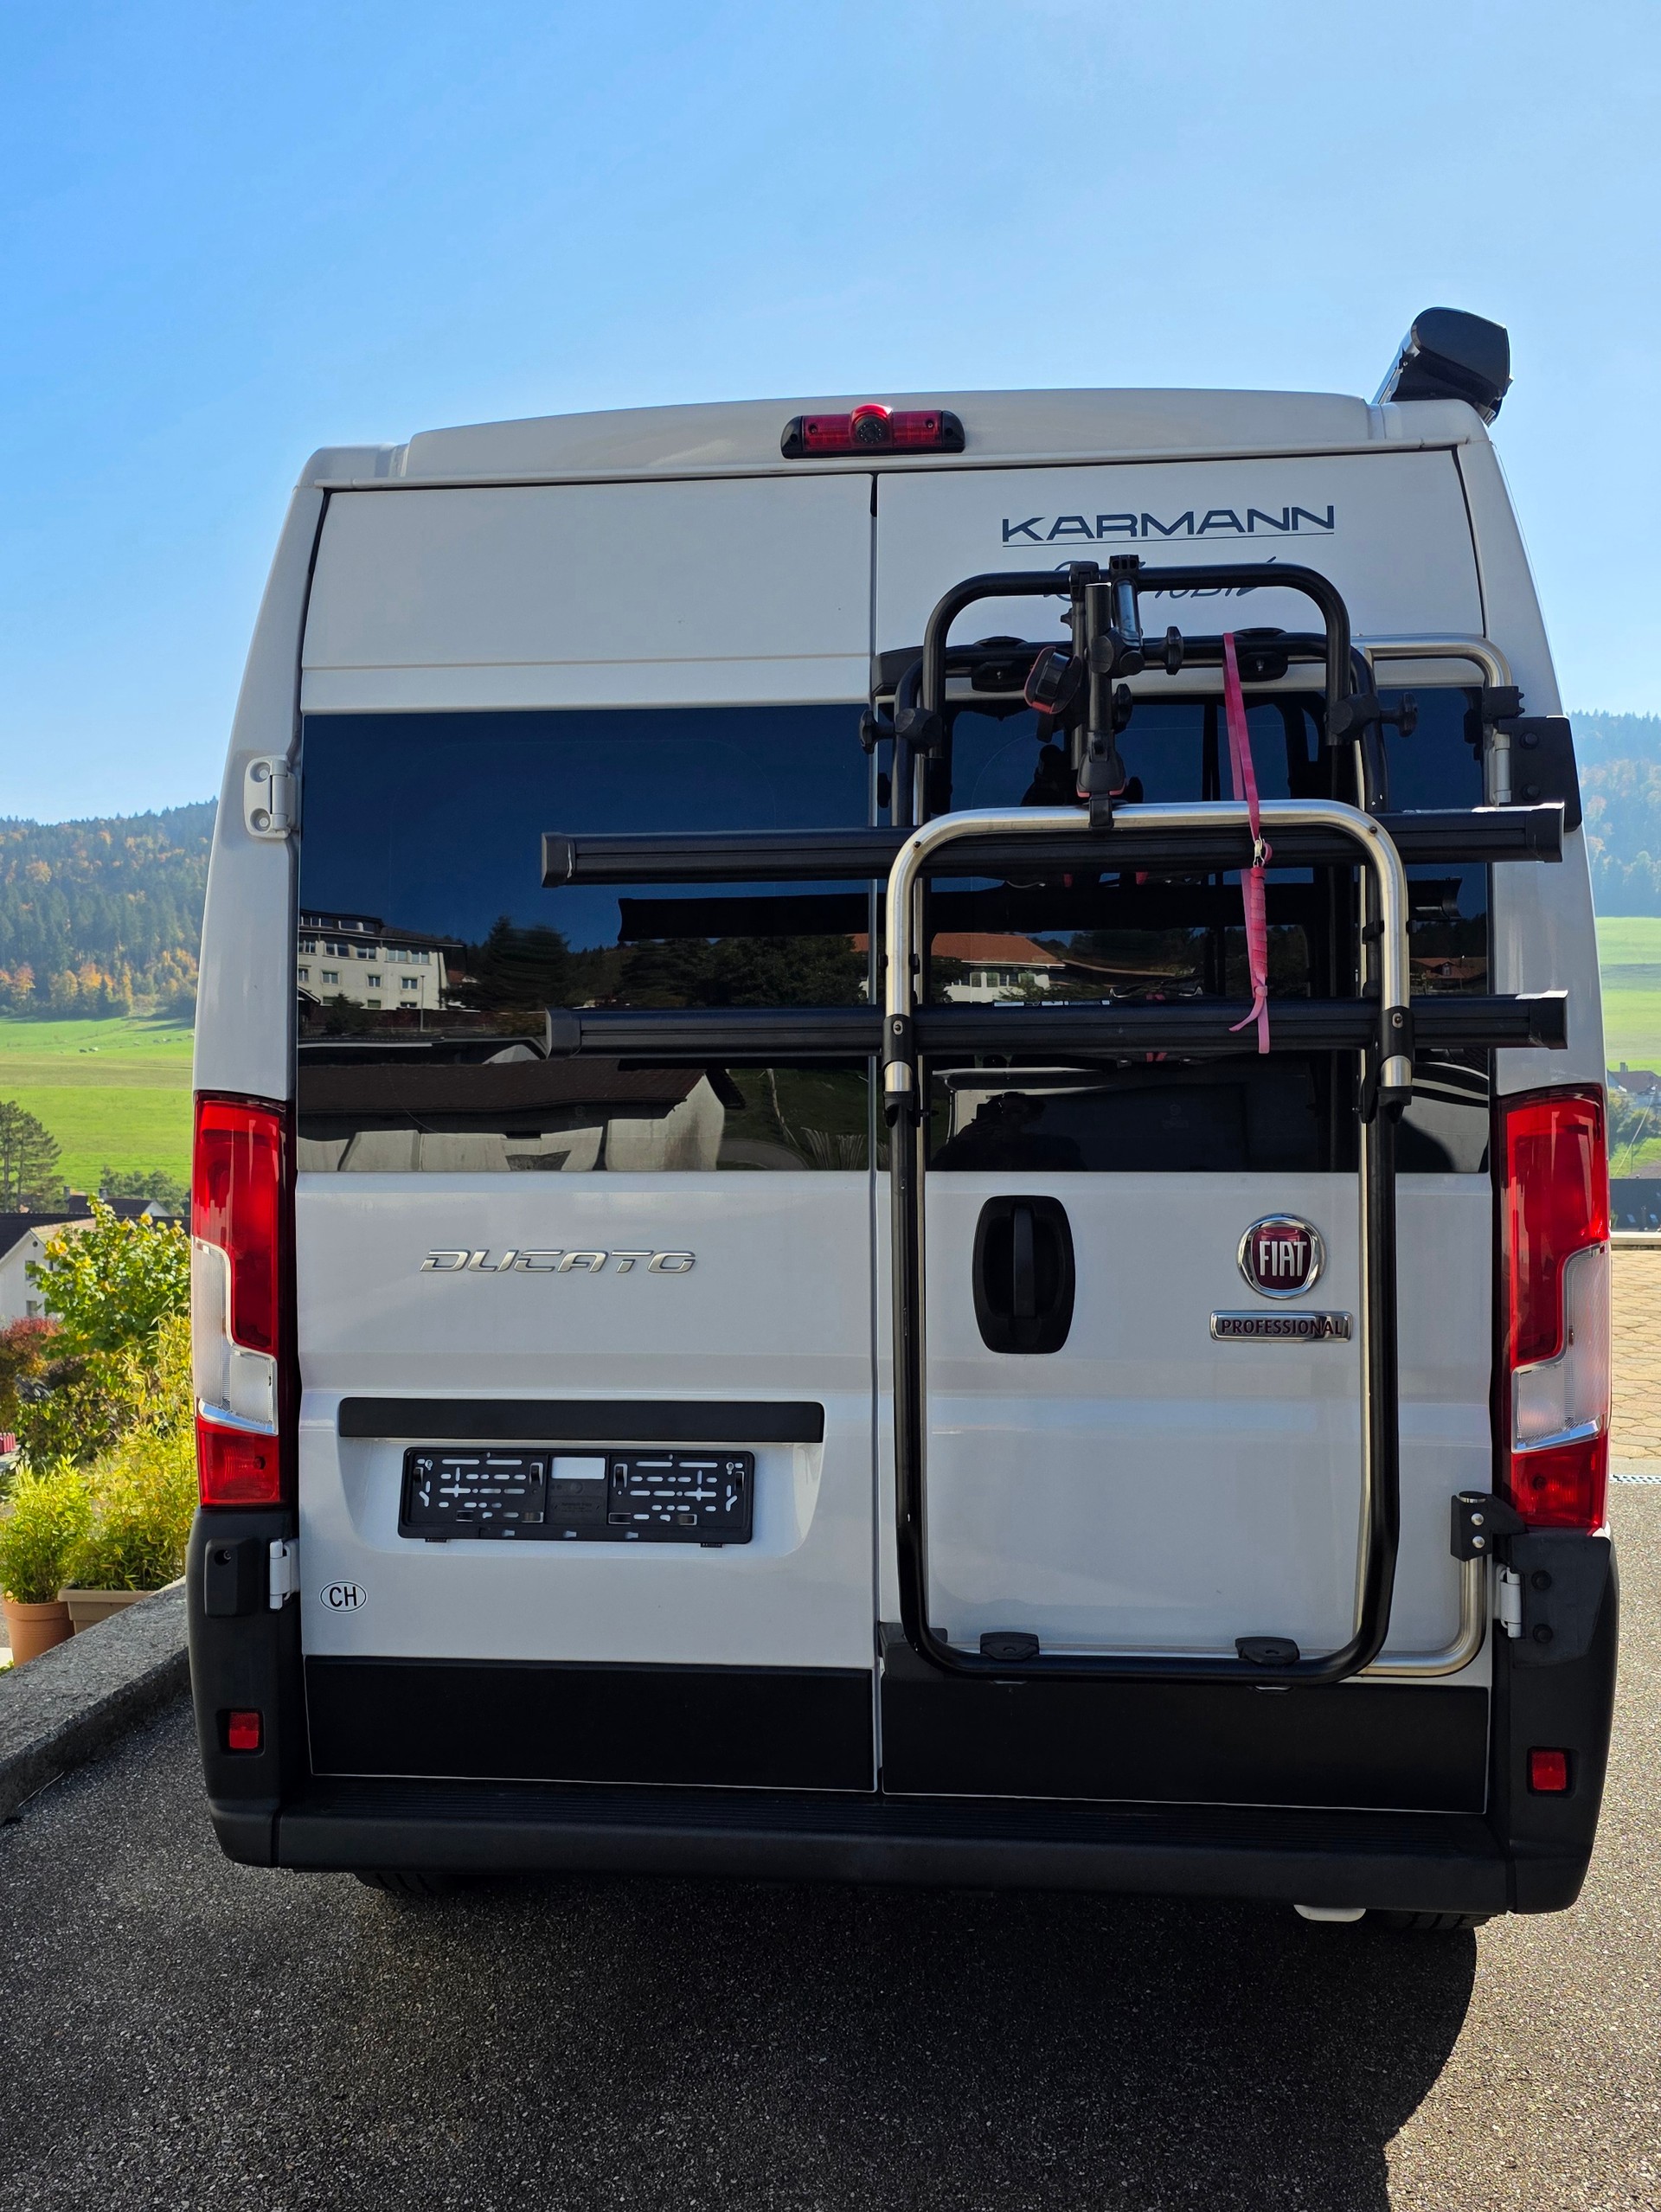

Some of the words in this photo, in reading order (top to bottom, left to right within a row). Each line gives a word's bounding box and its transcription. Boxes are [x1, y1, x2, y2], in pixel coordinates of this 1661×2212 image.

[1002, 505, 1335, 543] KARMANN
[420, 1248, 696, 1273] DUCATO
[1259, 1241, 1307, 1277] FIAT
[1221, 1318, 1342, 1336] PROFESSIONAL
[329, 1586, 357, 1607] CH
